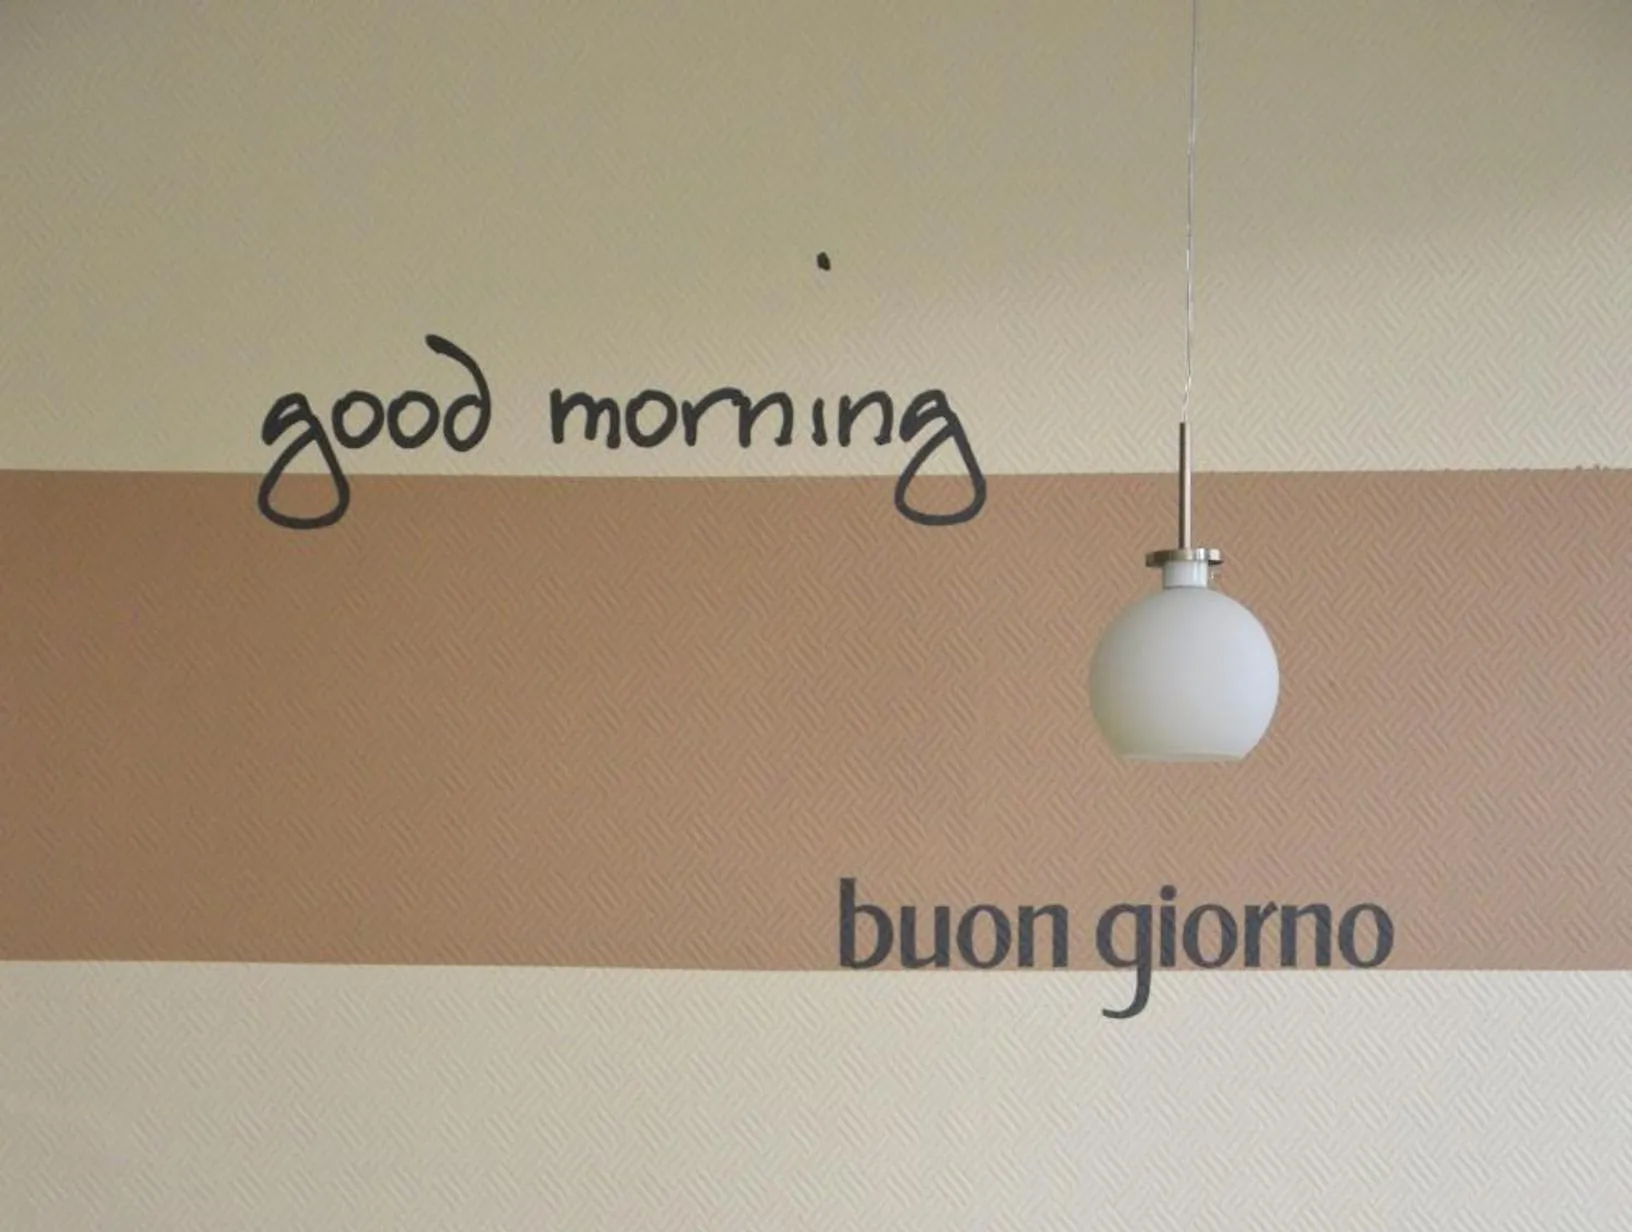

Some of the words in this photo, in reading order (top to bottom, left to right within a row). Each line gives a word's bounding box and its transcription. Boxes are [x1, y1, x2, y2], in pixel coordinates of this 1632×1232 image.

[256, 333, 491, 531] good
[839, 877, 1068, 970] buon
[1094, 884, 1394, 1020] giorno
